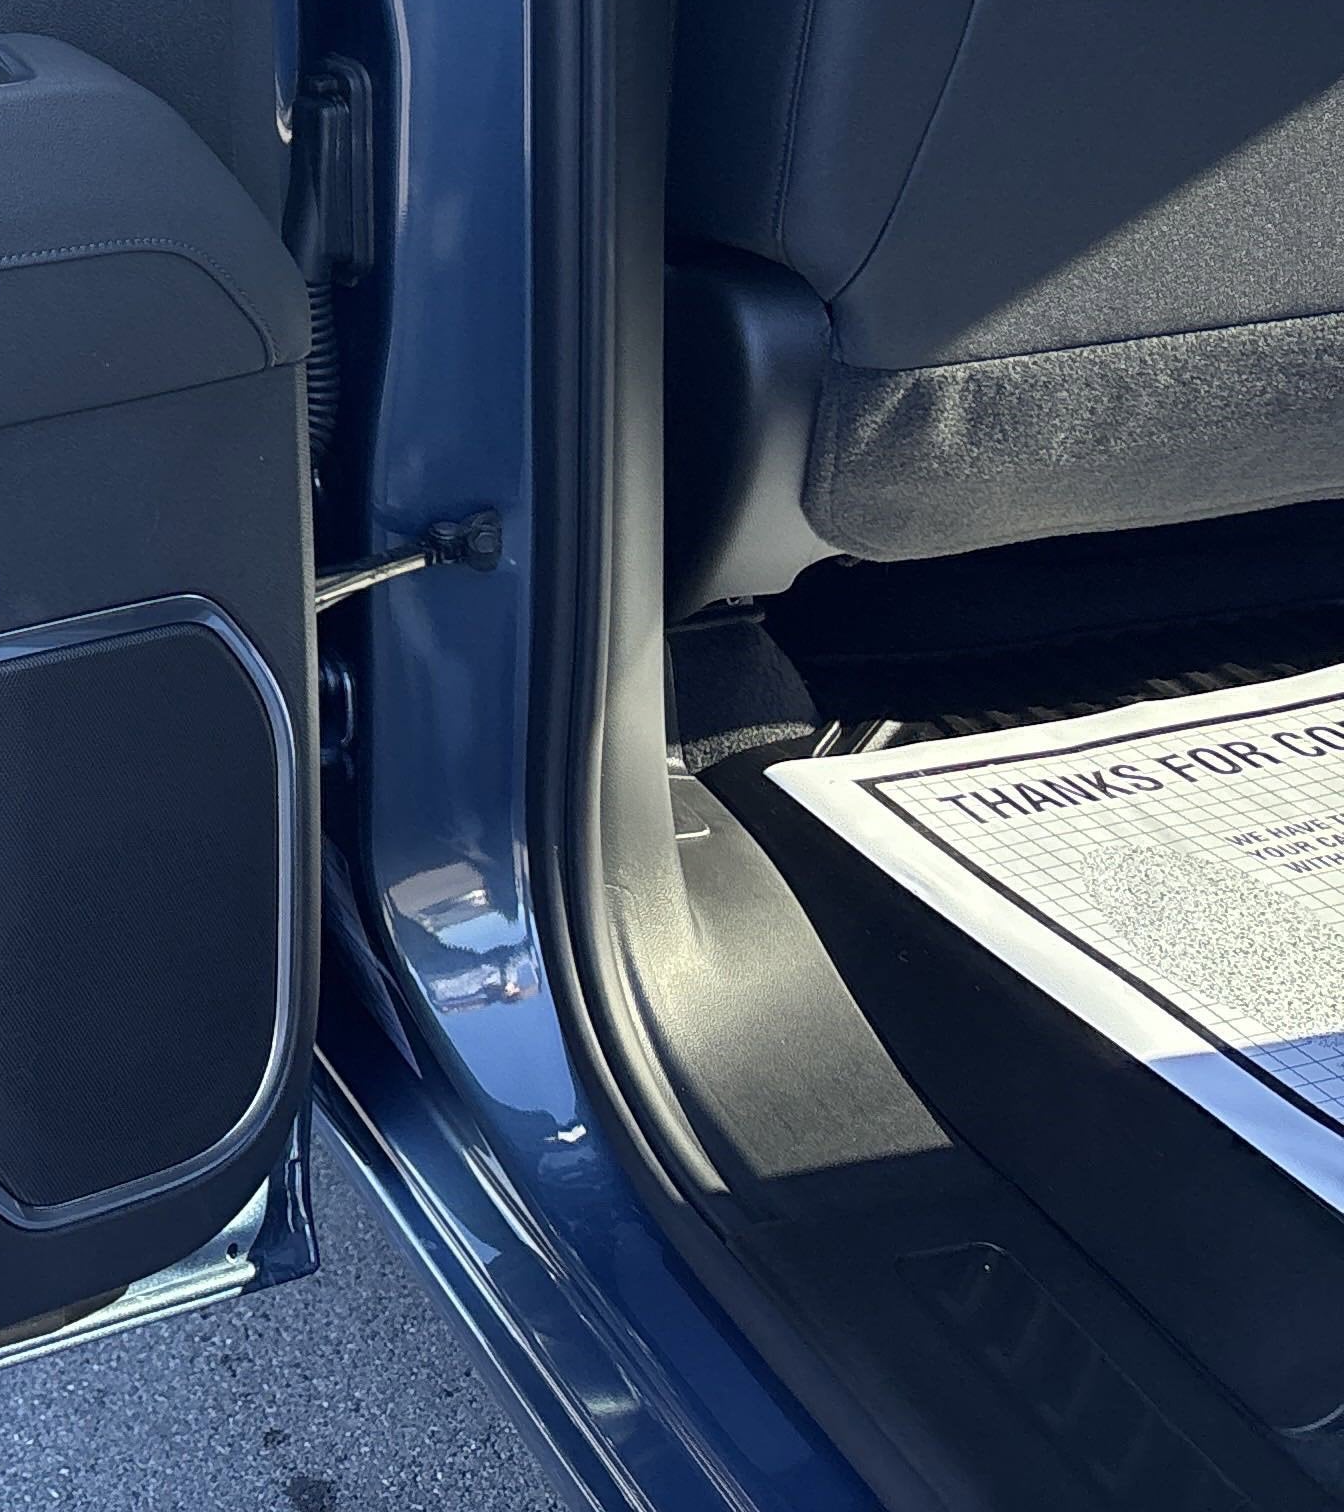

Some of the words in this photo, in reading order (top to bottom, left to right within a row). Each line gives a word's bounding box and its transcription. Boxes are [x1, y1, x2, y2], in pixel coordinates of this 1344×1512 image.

[937, 764, 1164, 824] THANKS
[1155, 740, 1283, 784] FOR
[1271, 719, 1344, 757] CO
[1223, 830, 1270, 846] WE
[1265, 818, 1332, 839] HAVE
[1244, 840, 1319, 861] YOUR
